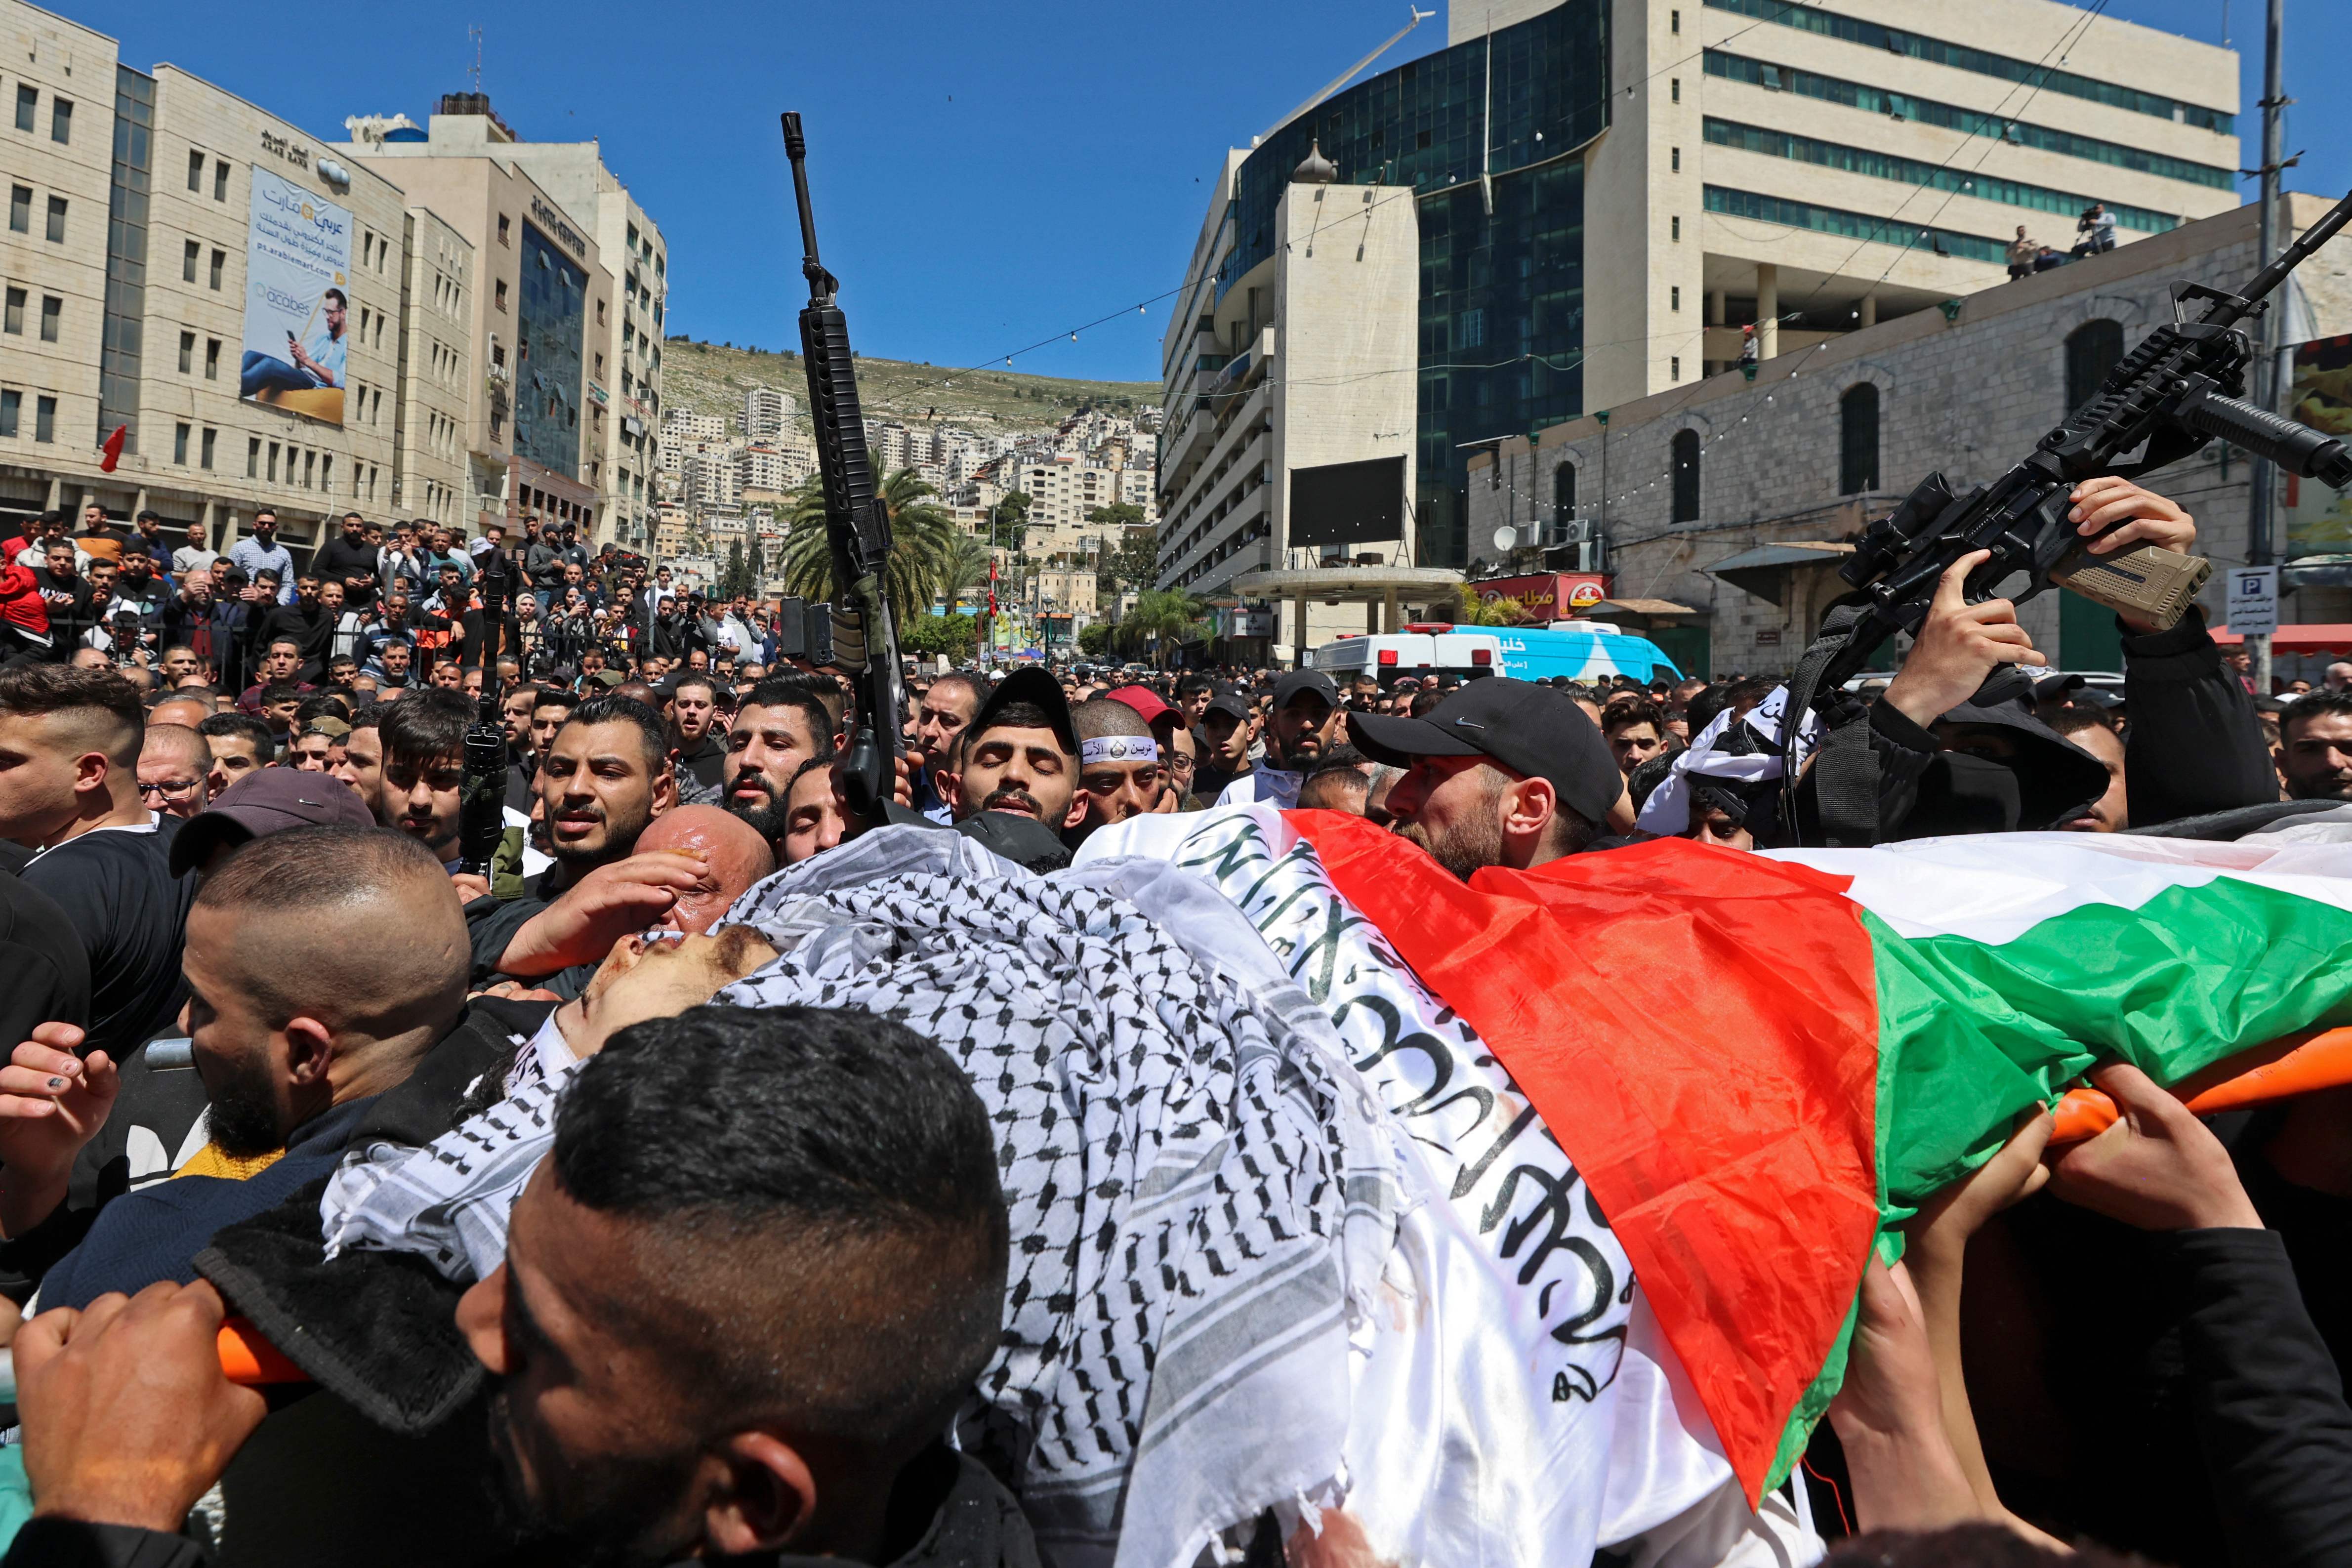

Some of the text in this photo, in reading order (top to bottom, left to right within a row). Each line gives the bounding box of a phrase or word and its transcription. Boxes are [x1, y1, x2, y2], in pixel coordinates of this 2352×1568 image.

[262, 190, 343, 235] عربي مارت
[267, 290, 310, 316] acabes
[2245, 579, 2258, 594] P
[1516, 590, 1555, 606] مطاع
